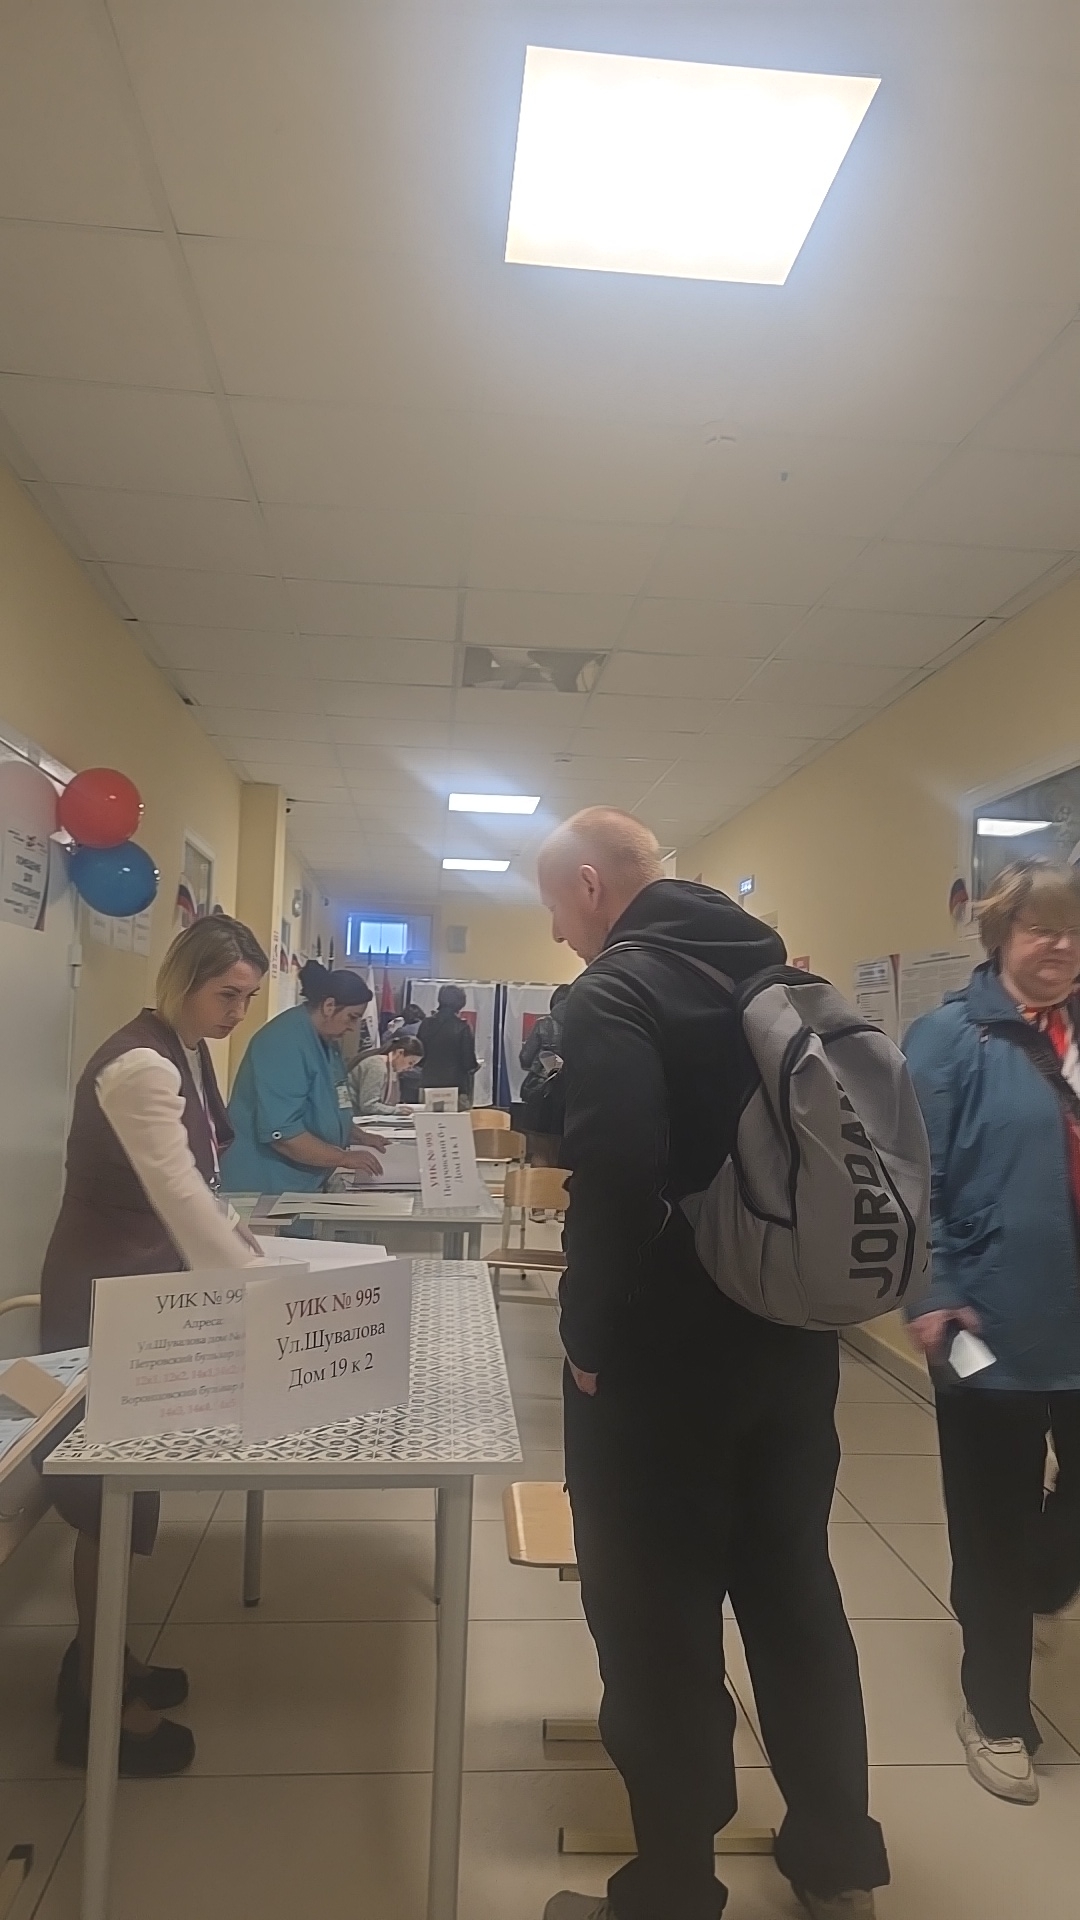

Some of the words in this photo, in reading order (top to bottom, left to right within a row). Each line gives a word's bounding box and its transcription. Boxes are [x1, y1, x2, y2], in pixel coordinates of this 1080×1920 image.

[427, 1150, 436, 1161] №
[429, 1163, 440, 1187] УИК
[454, 1163, 464, 1183] Дом
[156, 1292, 198, 1315] УИК
[202, 1290, 223, 1307] №
[226, 1288, 245, 1304] 99
[285, 1293, 328, 1324] УИК
[332, 1291, 353, 1313] №
[355, 1286, 382, 1307] 995
[276, 1322, 386, 1360] Ул.Шувалова
[288, 1368, 325, 1391] Дом
[330, 1358, 348, 1378] 19
[351, 1361, 361, 1374] к
[365, 1352, 374, 1371] 2
